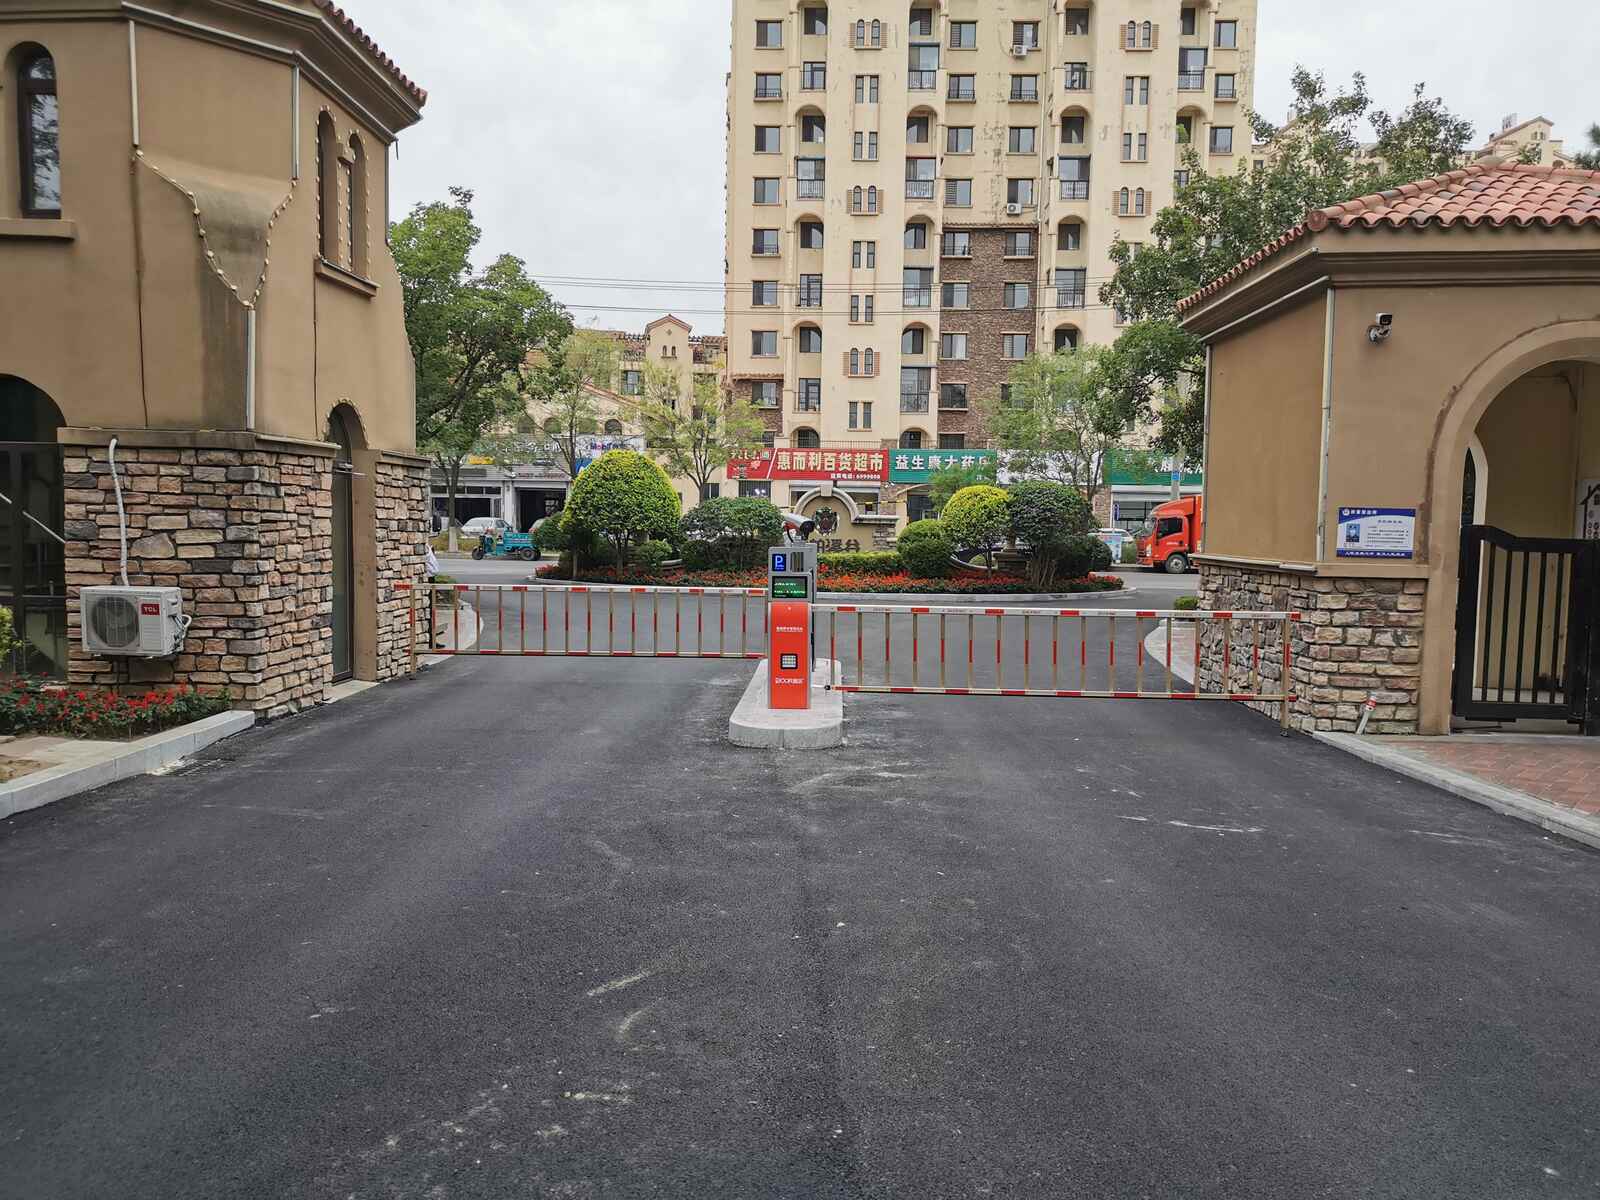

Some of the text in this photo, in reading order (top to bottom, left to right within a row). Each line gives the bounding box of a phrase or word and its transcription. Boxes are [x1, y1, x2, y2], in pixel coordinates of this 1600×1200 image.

[777, 451, 884, 471] 惠而利百货超市
